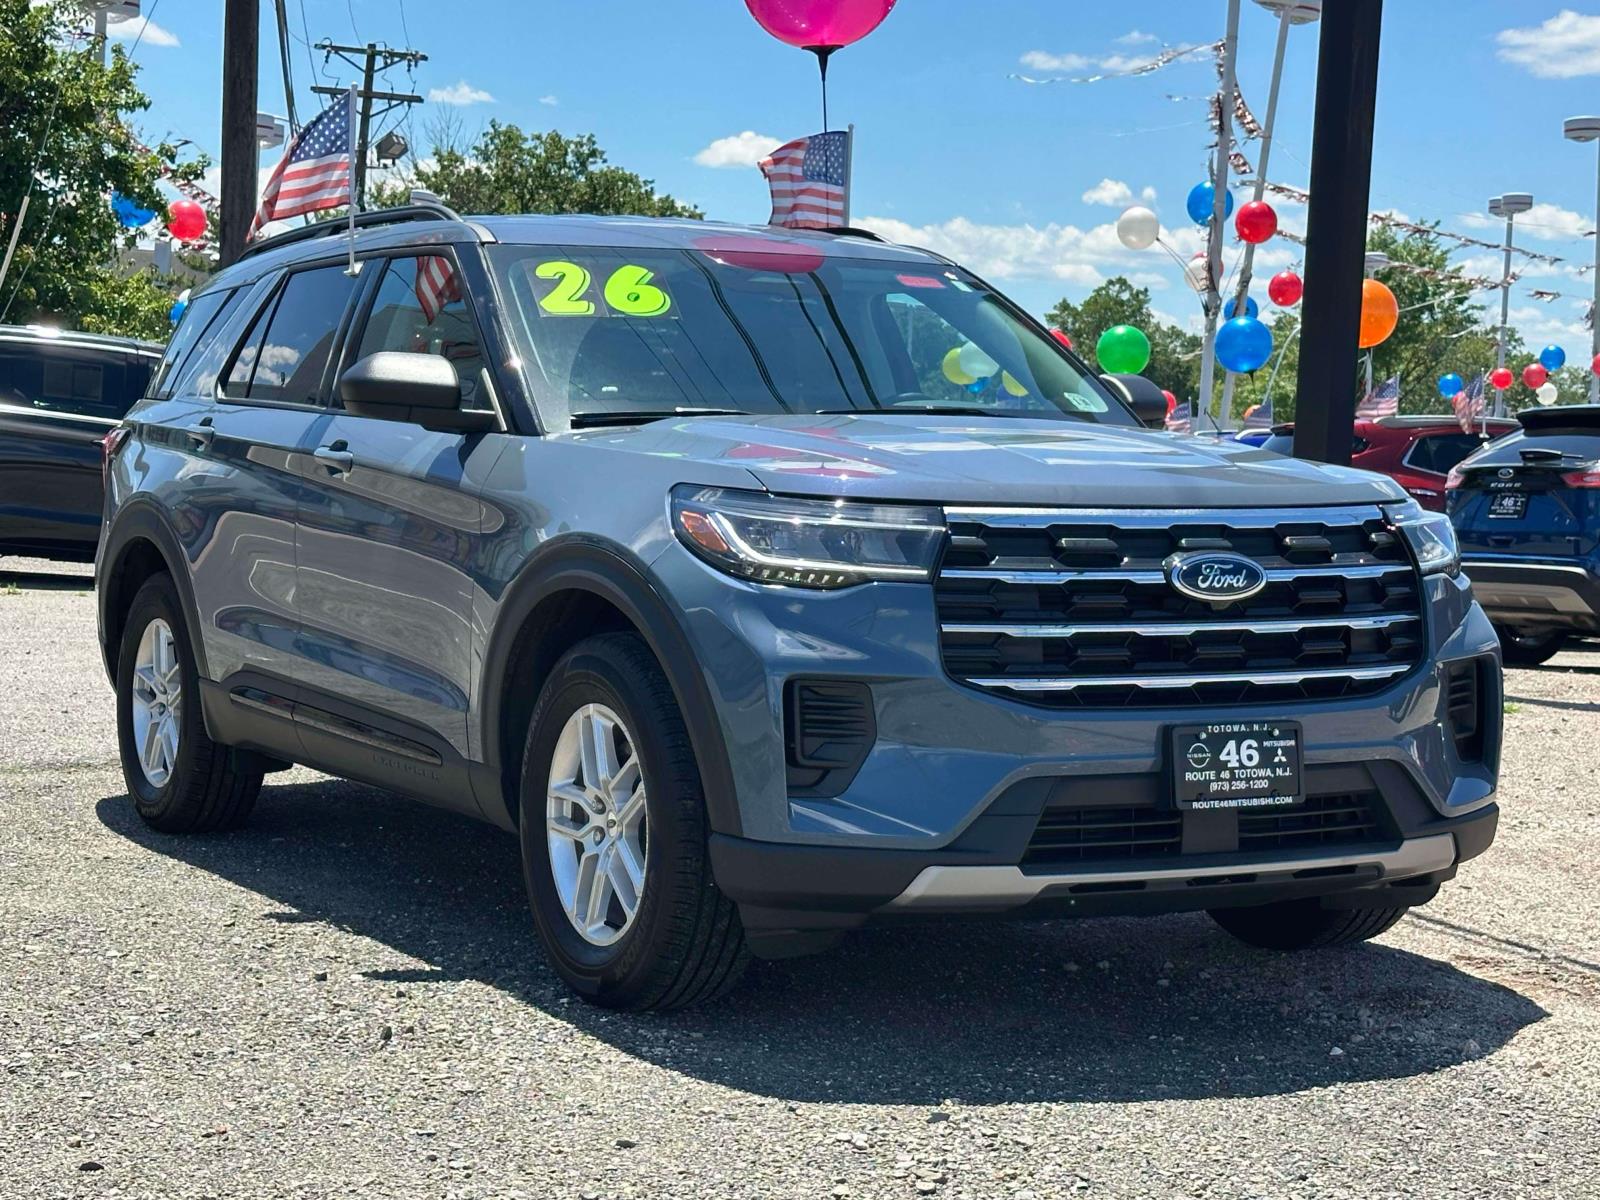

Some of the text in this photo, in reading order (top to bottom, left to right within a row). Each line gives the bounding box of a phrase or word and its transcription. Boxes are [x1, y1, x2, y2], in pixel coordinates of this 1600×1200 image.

[535, 261, 671, 317] 26
[1502, 497, 1515, 506] 46
[1198, 563, 1247, 588] Ford
[1253, 723, 1272, 732] N.J.
[1219, 739, 1260, 768] 46
[1185, 767, 1292, 781] ROUTE 46 TOTOWA, N.J.
[1209, 779, 1269, 792] (973) 256-1200
[1192, 796, 1293, 809] ROUTE46MITSUBISHI.COM
